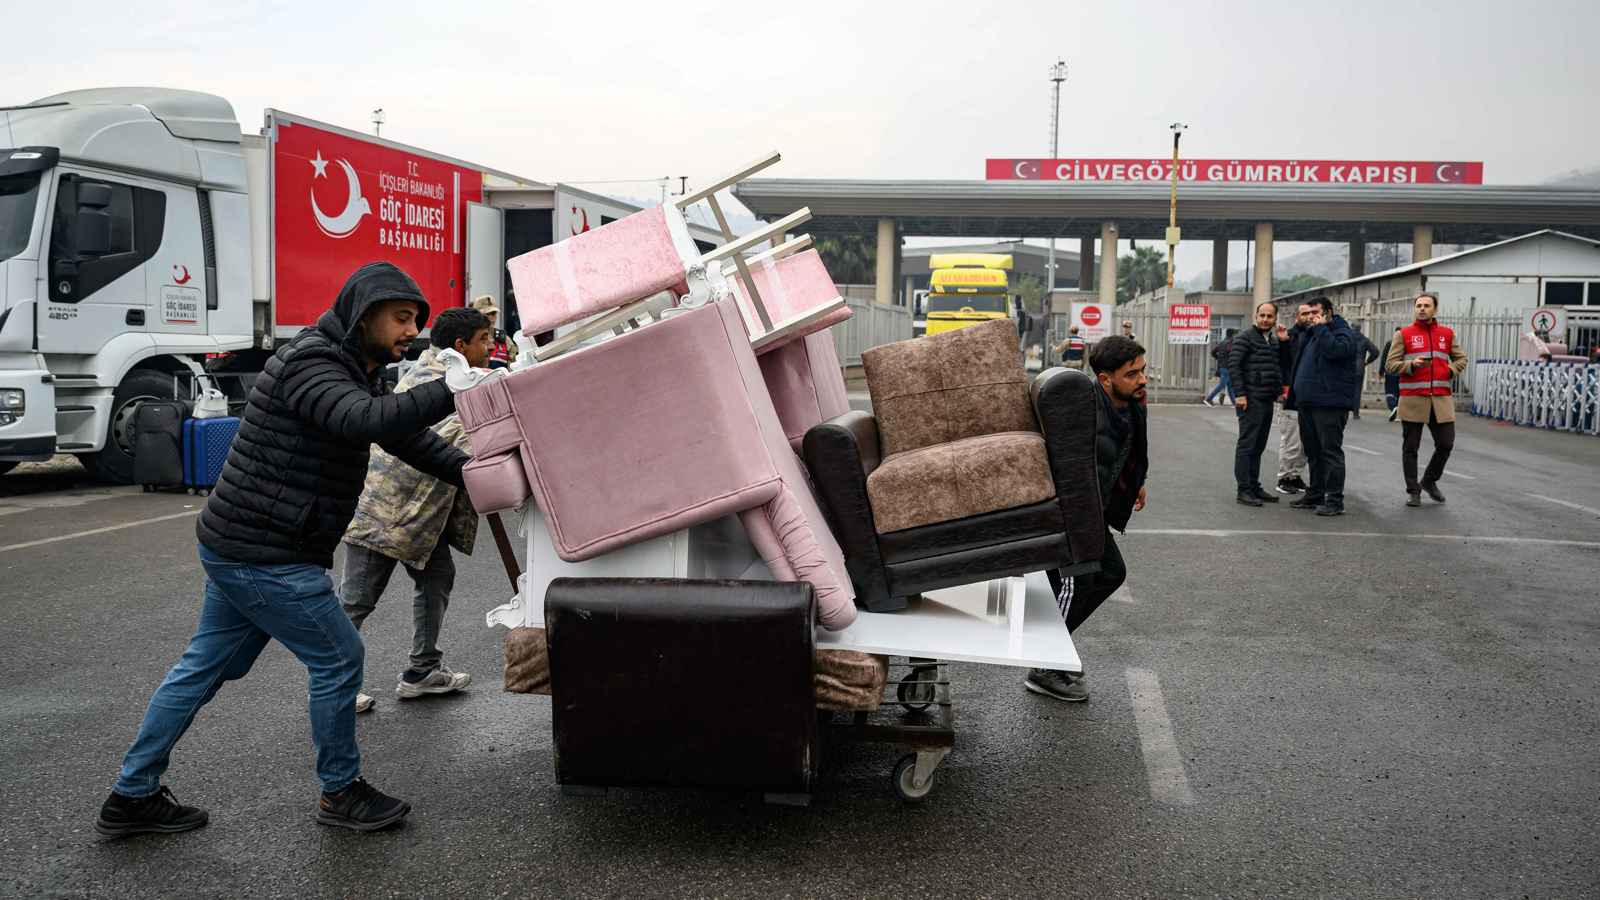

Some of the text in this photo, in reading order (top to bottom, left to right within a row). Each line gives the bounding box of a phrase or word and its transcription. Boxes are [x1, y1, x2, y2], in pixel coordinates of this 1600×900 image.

[379, 170, 445, 201] İÇİŞLERİ BAKANLIĞI
[1056, 159, 1417, 184] CİLVEGÖZÜ GÜMRÜK KAPISI
[380, 194, 445, 231] GÖÇ İDARESİ
[380, 227, 445, 253] BAŞKANLIĞI
